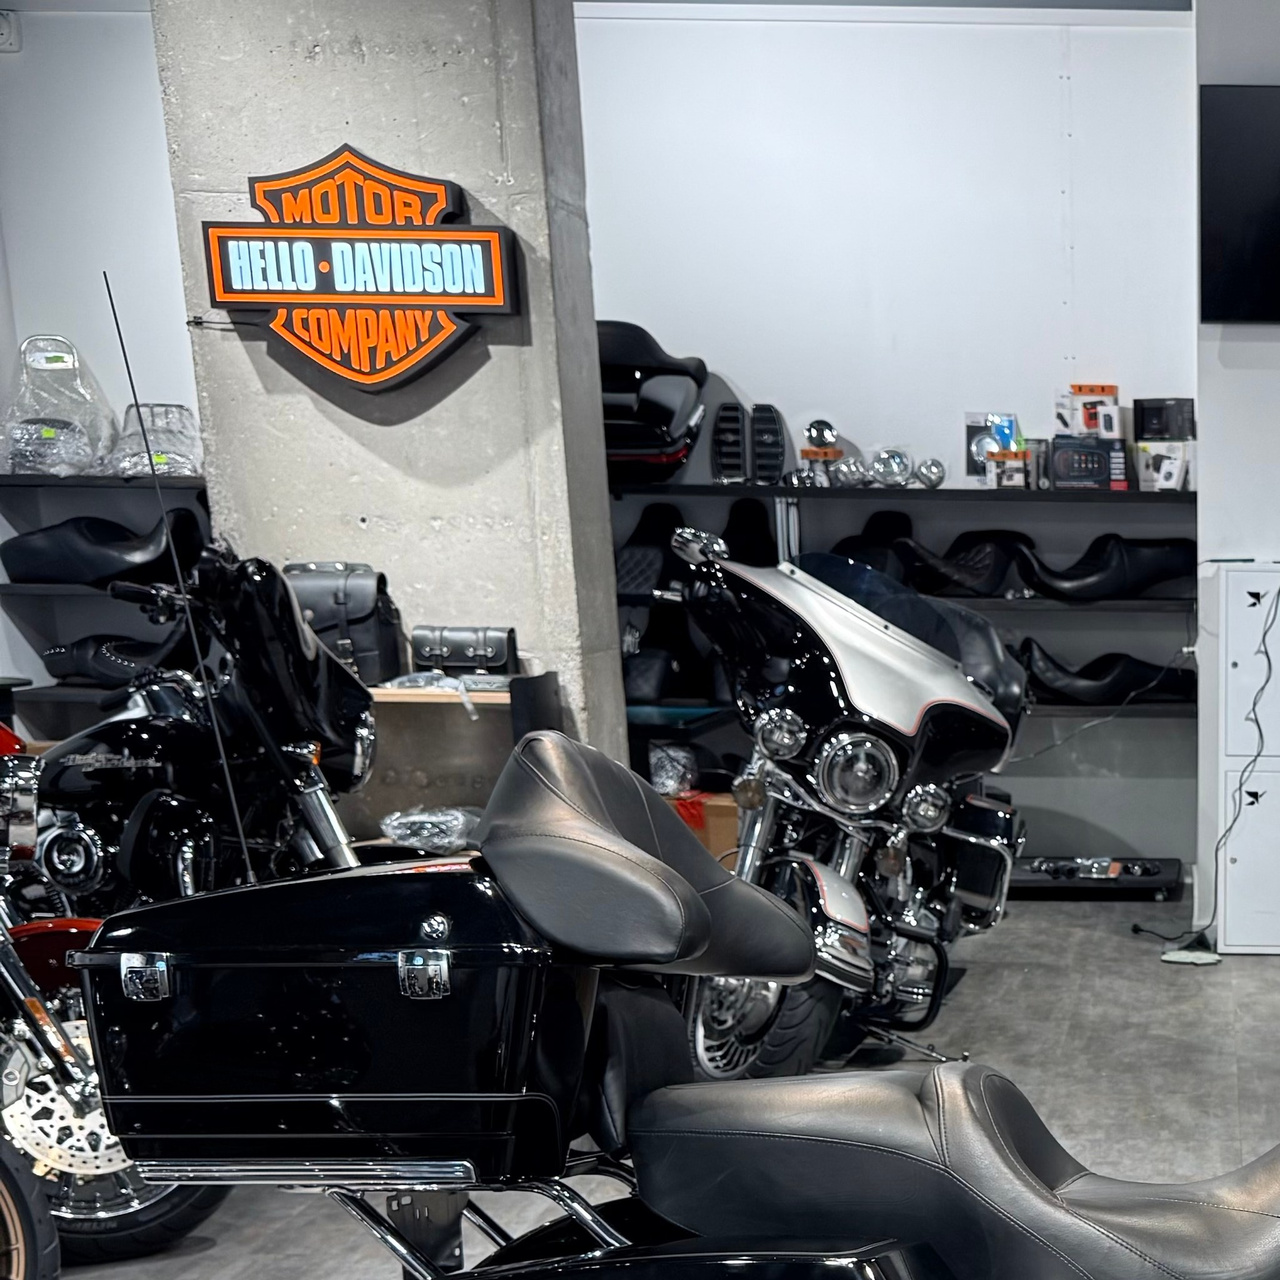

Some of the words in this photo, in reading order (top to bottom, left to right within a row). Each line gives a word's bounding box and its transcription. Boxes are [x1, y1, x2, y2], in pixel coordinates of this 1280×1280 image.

[281, 167, 423, 226] MOTOR
[227, 240, 317, 291] HELLO
[330, 241, 486, 294] DAVIDSON
[292, 308, 433, 373] COMPANY
